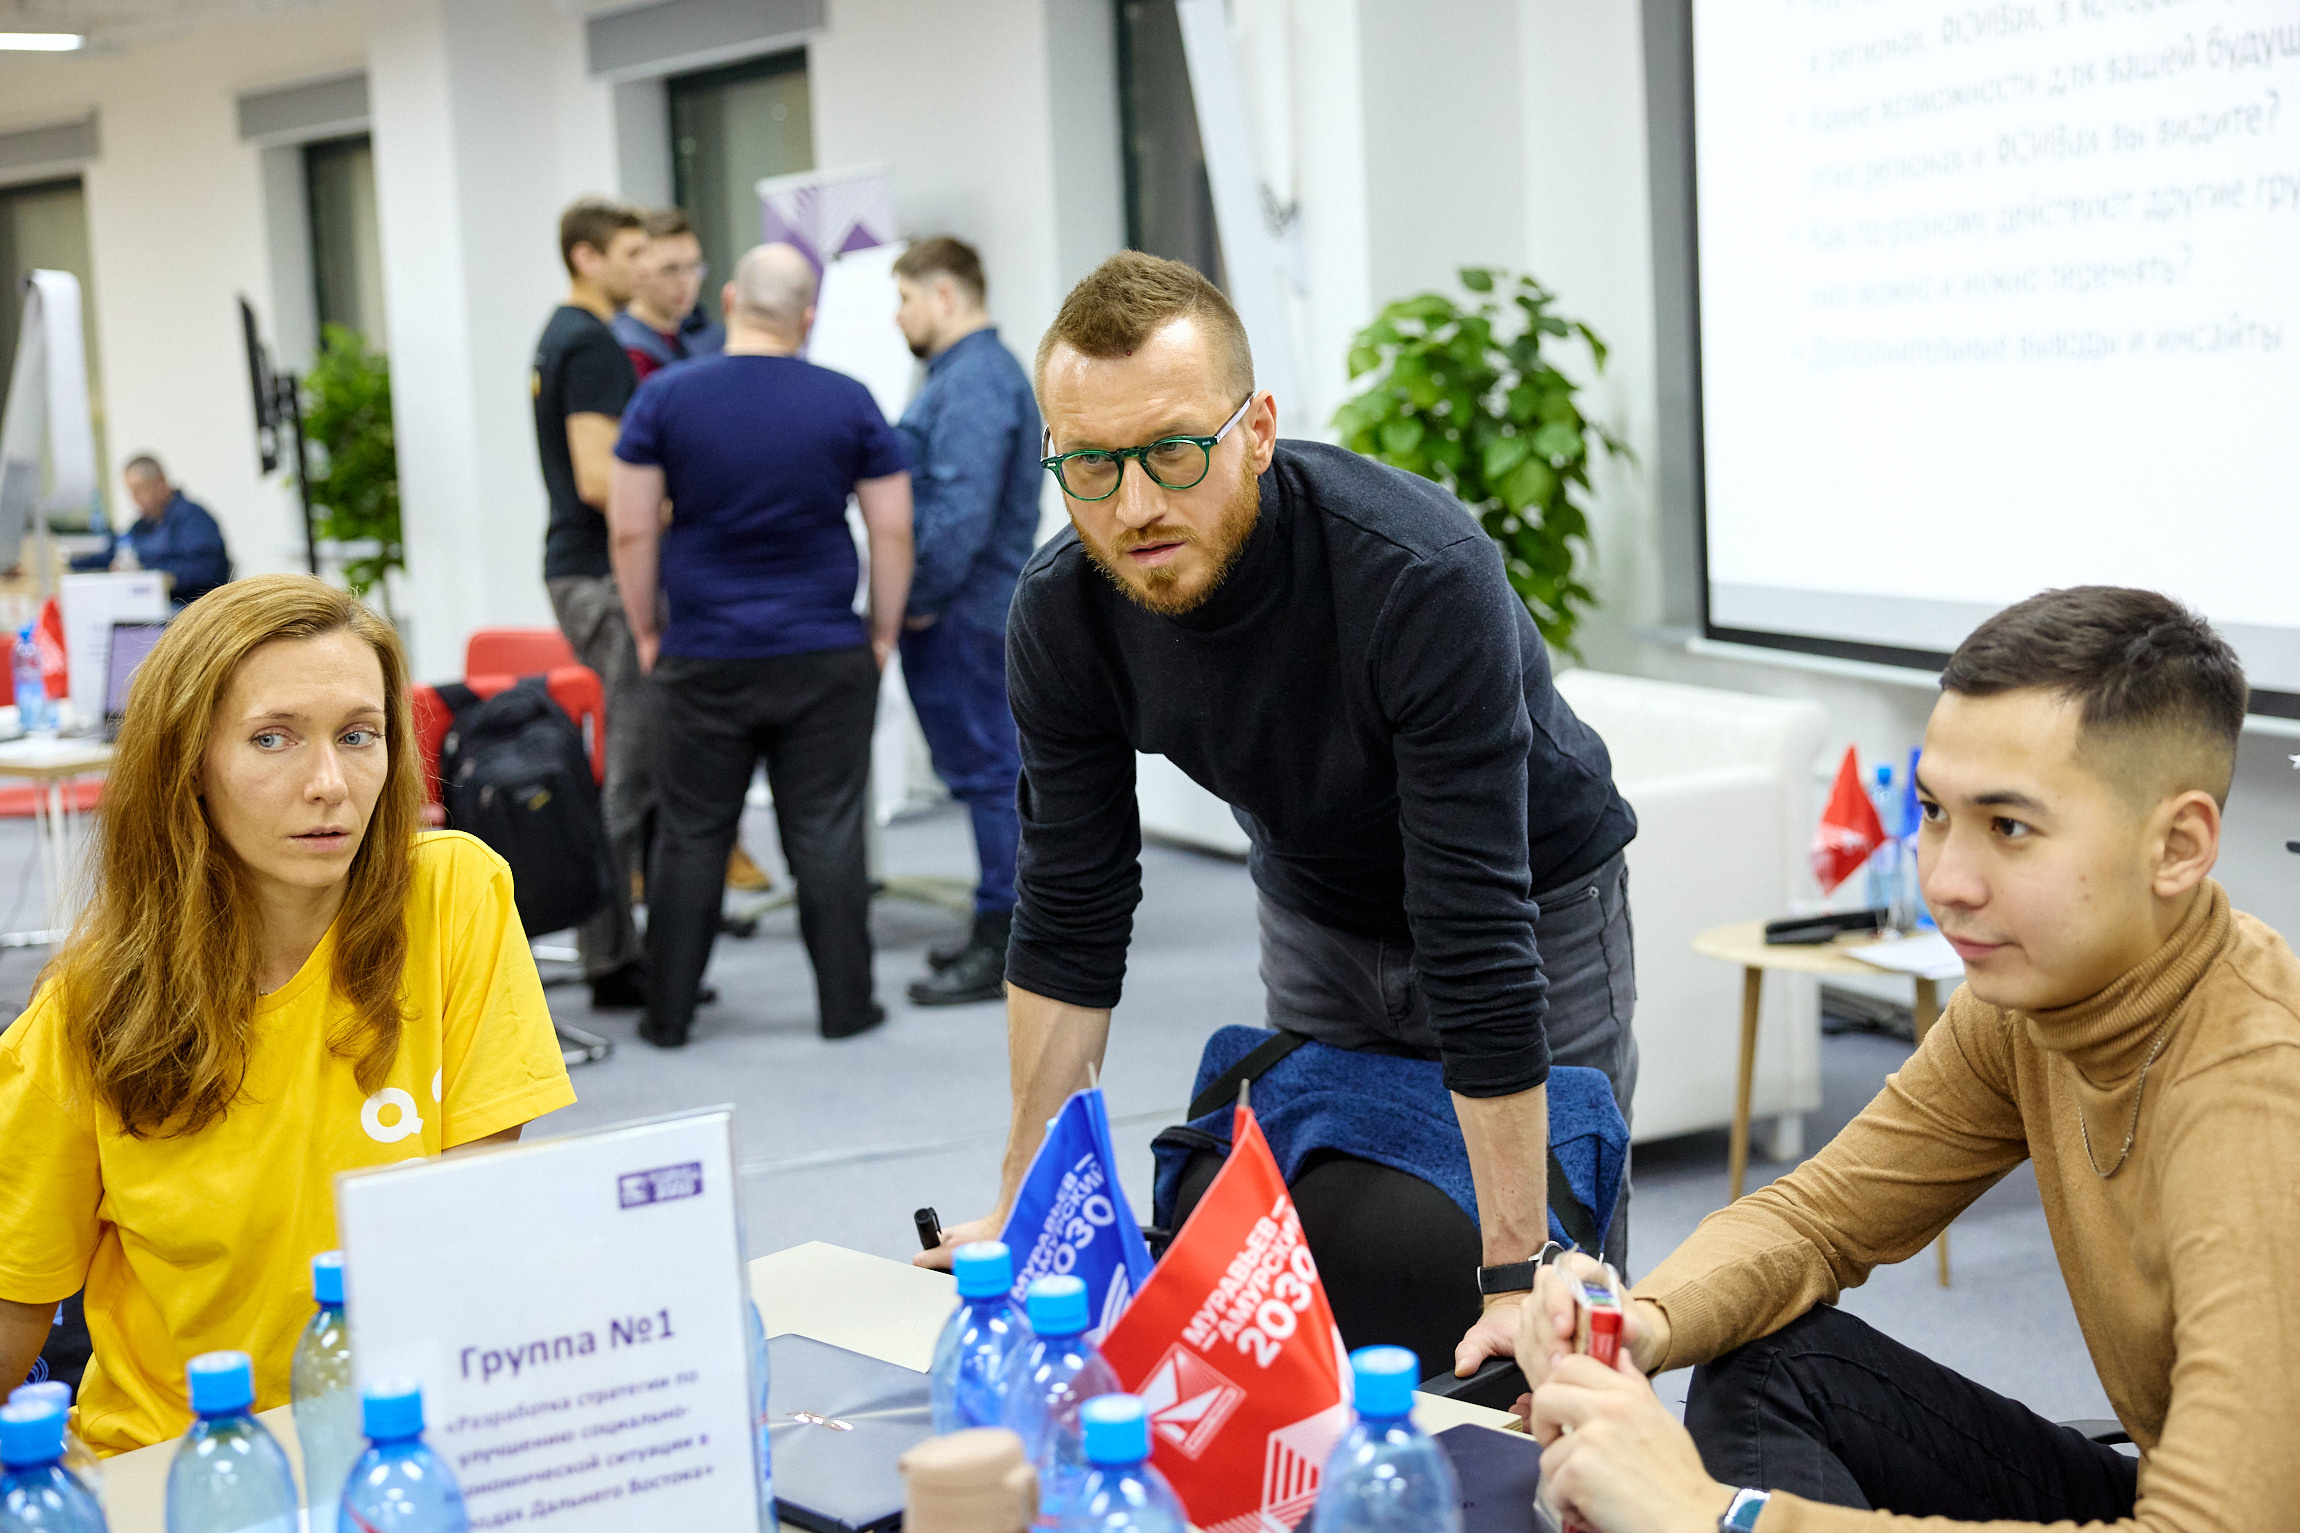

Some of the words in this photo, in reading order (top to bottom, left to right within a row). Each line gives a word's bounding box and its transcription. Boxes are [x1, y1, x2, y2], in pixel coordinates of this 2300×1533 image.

[1049, 1194, 1115, 1275] 030
[459, 1329, 597, 1382] Группа
[611, 1307, 674, 1350] №1
[1236, 1244, 1318, 1368] 2030
